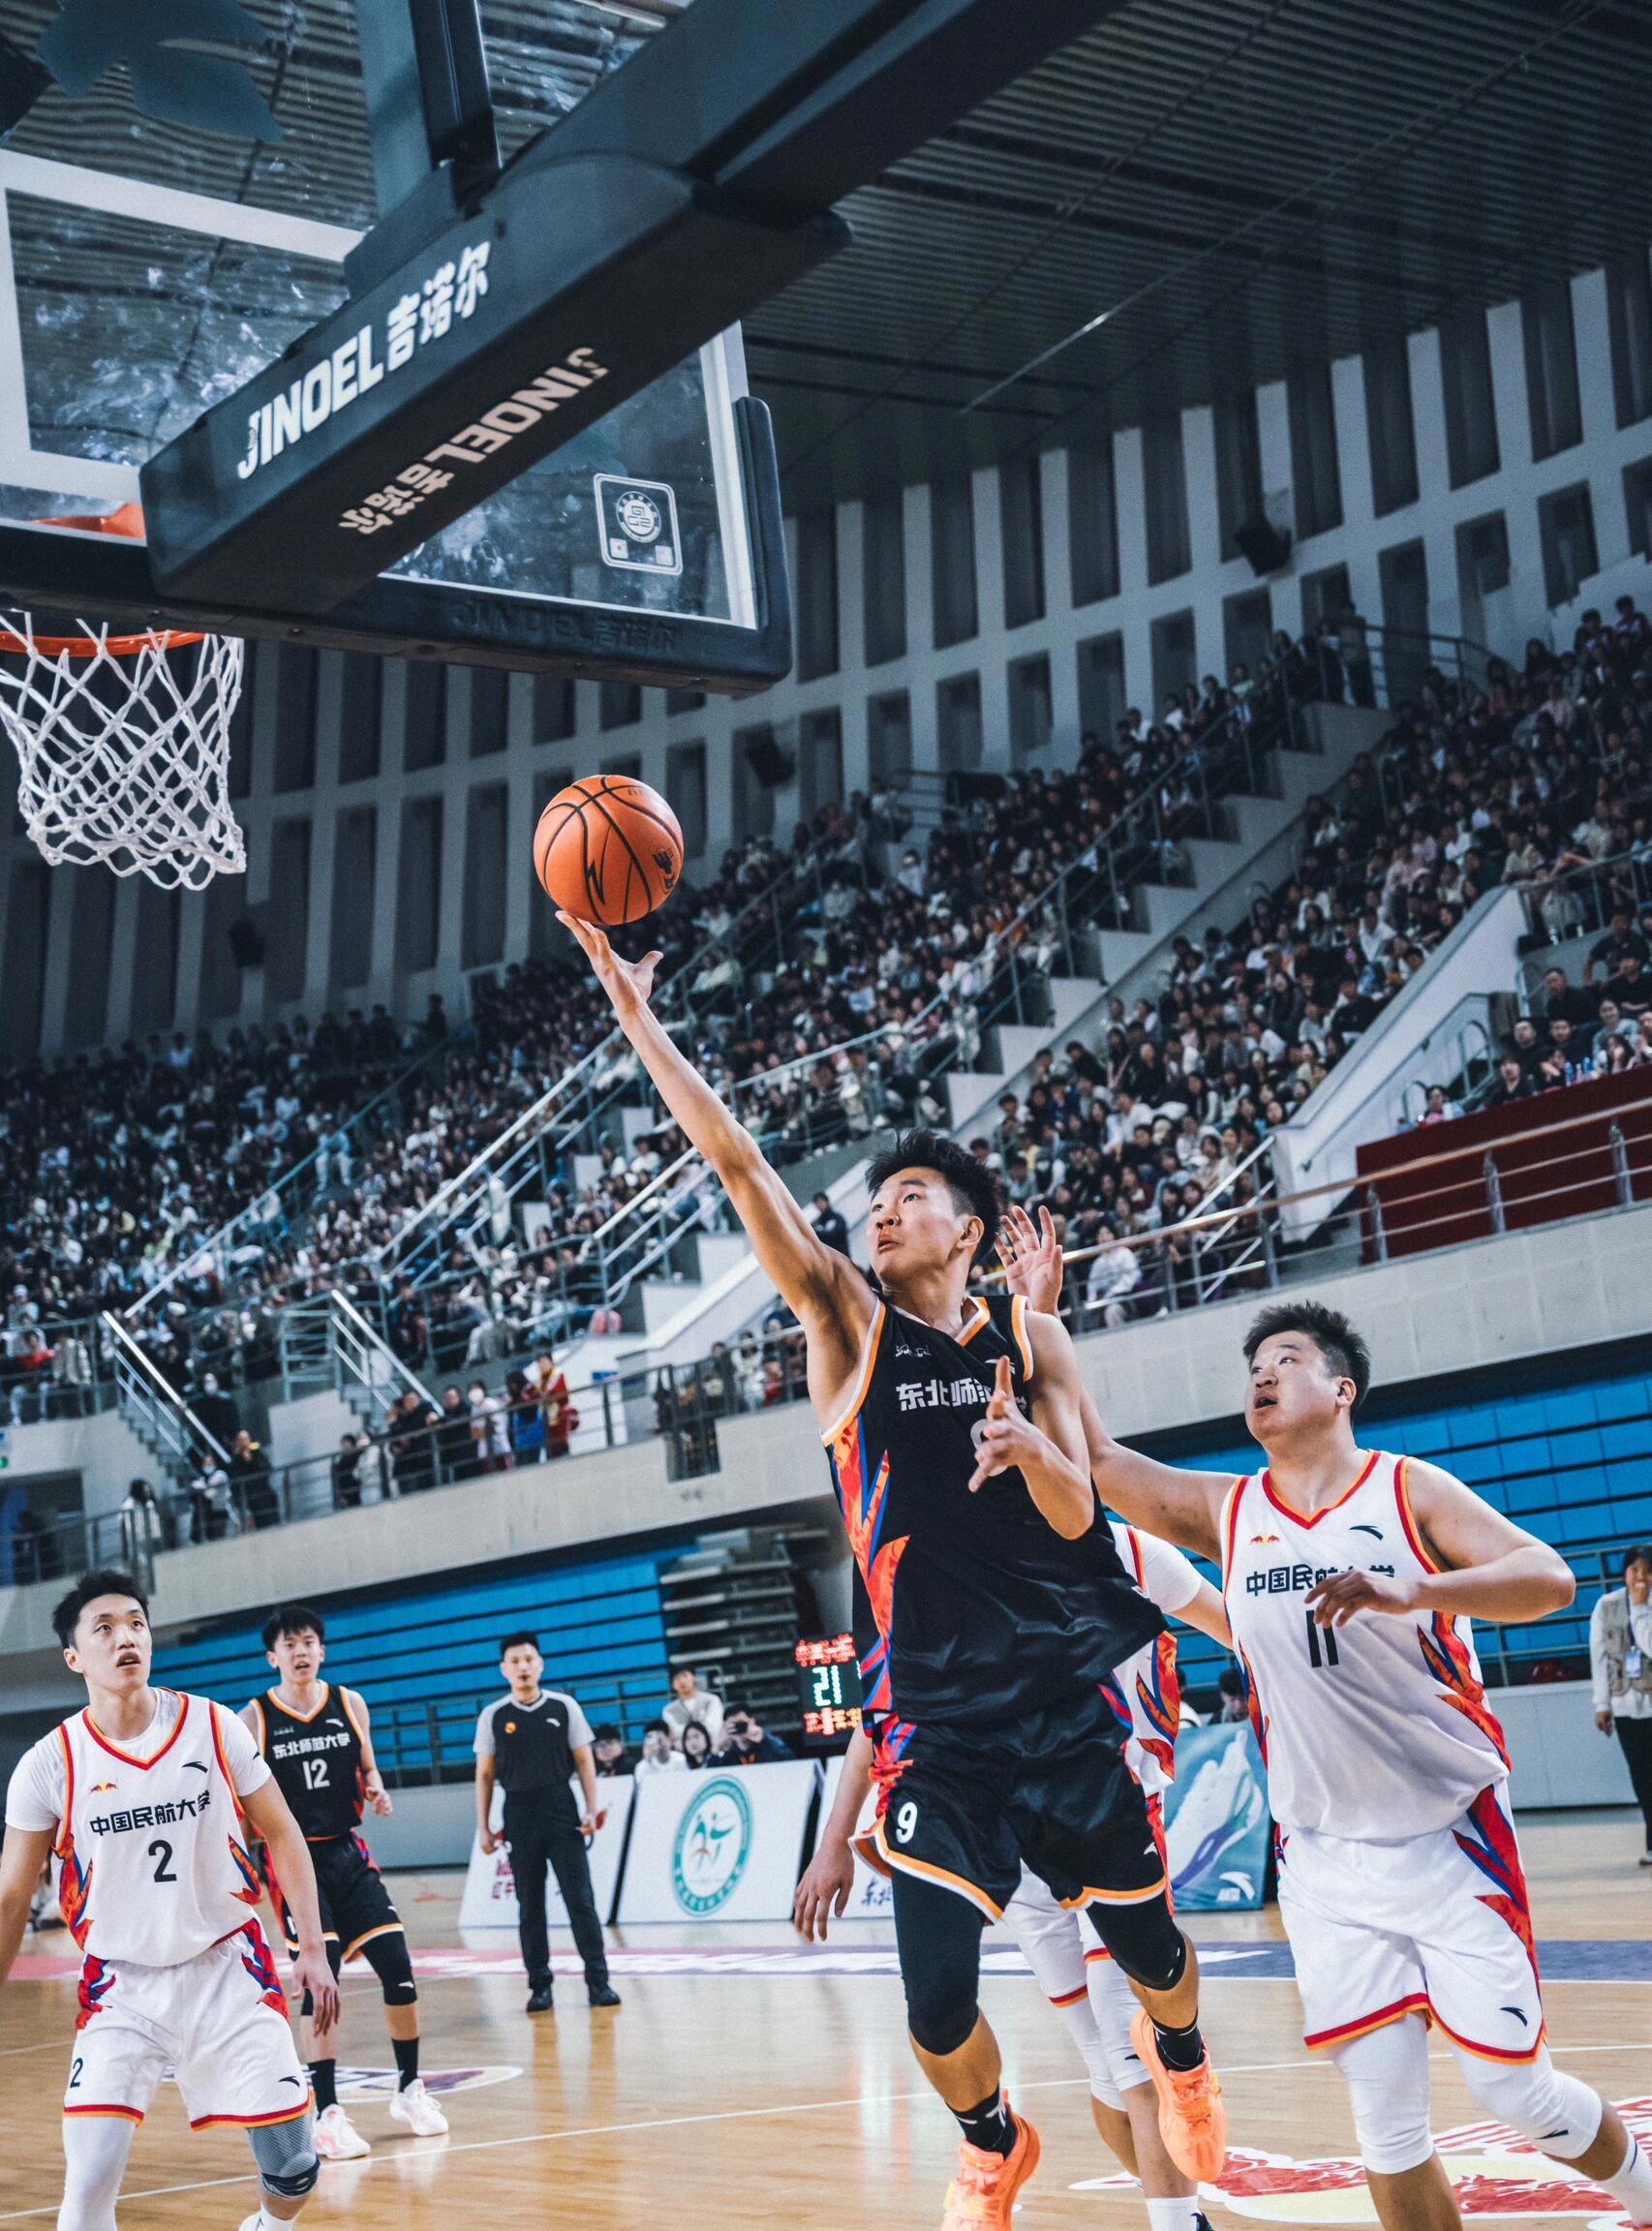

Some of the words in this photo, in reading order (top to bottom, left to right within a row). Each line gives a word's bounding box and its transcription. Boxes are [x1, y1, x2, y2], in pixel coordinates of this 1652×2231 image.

[237, 324, 384, 479] JINOEL
[387, 241, 491, 372] 吉诺尔
[423, 347, 610, 465] JINOEL
[339, 463, 455, 535] 吉诺尔
[1305, 1609, 1339, 1668] 11
[812, 1665, 842, 1706] 21
[272, 1731, 351, 1759] 东北师范大学
[302, 1758, 330, 1790] 12
[90, 1789, 211, 1836] 中国民航大学
[896, 1801, 918, 1844] 9
[148, 1840, 177, 1882] 2
[70, 2058, 83, 2088] 2
